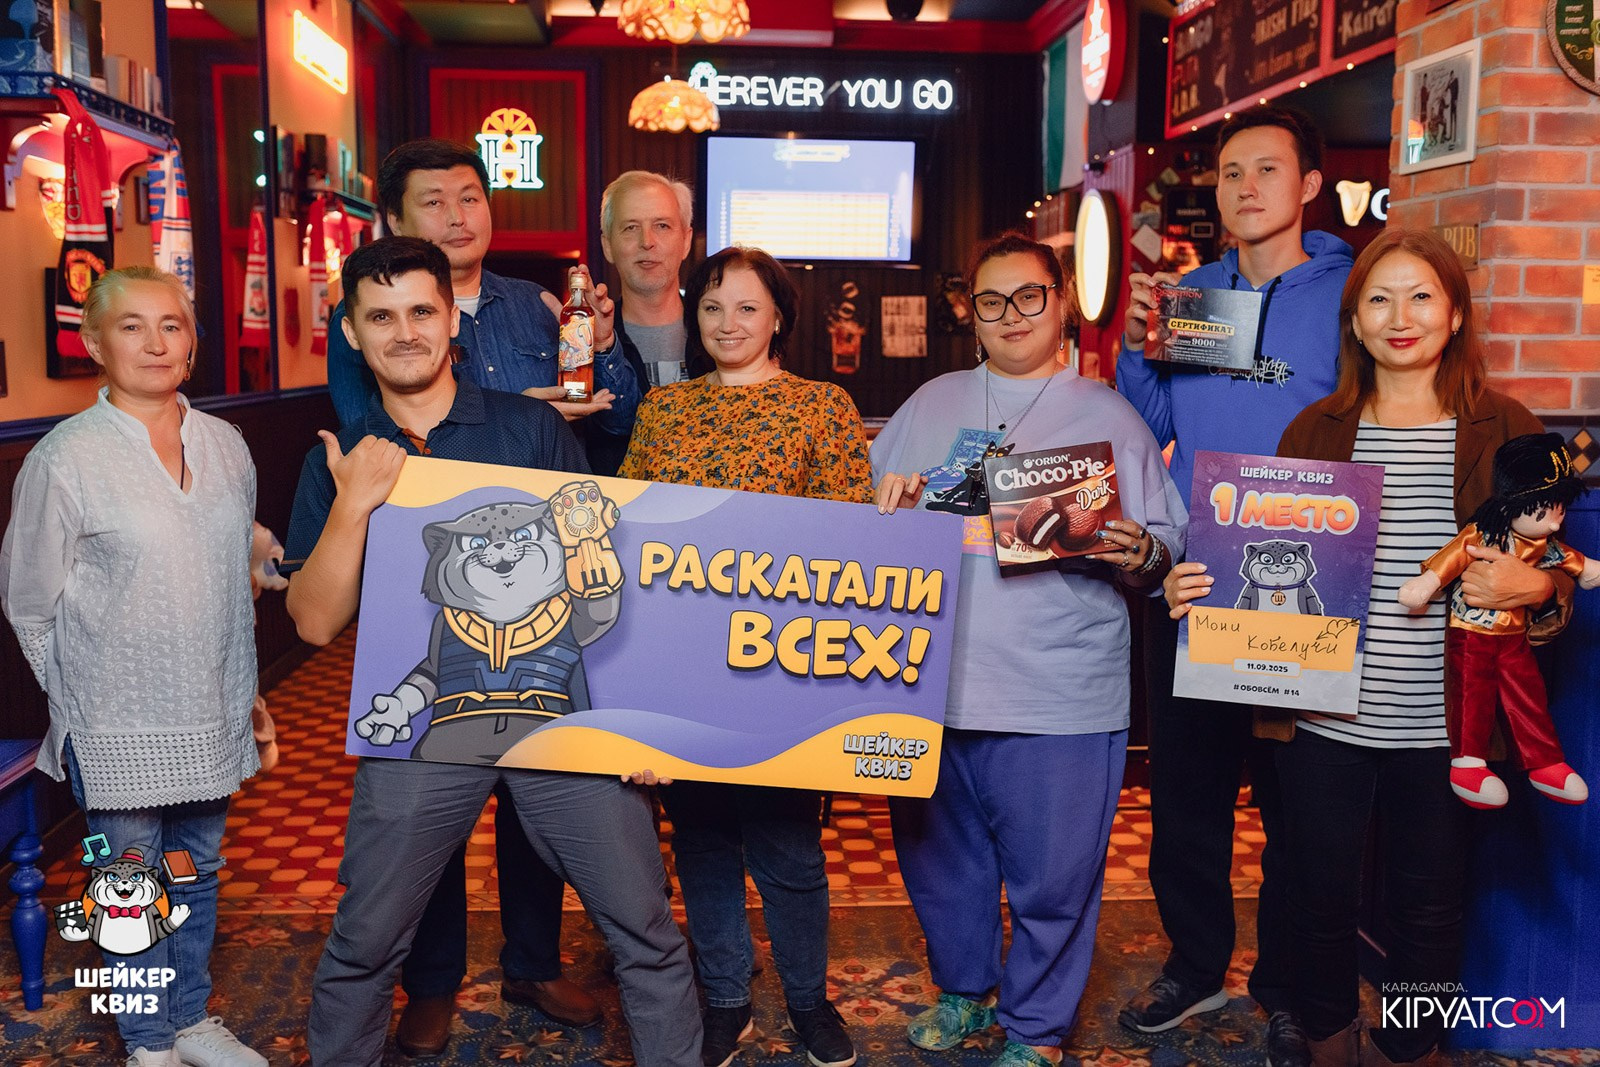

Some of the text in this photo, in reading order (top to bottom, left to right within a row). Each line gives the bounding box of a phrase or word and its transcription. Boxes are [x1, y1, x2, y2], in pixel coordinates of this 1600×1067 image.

[842, 78, 902, 109] YOU
[912, 79, 953, 110] GO
[1170, 319, 1234, 334] СЕРТИФИКАТ
[1191, 337, 1216, 347] 9000
[1034, 455, 1069, 466] ORION
[1239, 466, 1334, 485] ШЕЙКЕР КВИЗ
[1075, 479, 1116, 511] Dark
[1211, 483, 1358, 534] 1 МЕСТО
[638, 541, 944, 616] РАСКАТАЛИ
[1195, 615, 1241, 632] Мони
[726, 609, 931, 687] ВСЕХ!
[1246, 662, 1289, 673] 11.09.2025
[843, 732, 929, 759] ШЕЙКЕР
[854, 757, 913, 782] КВИЗ
